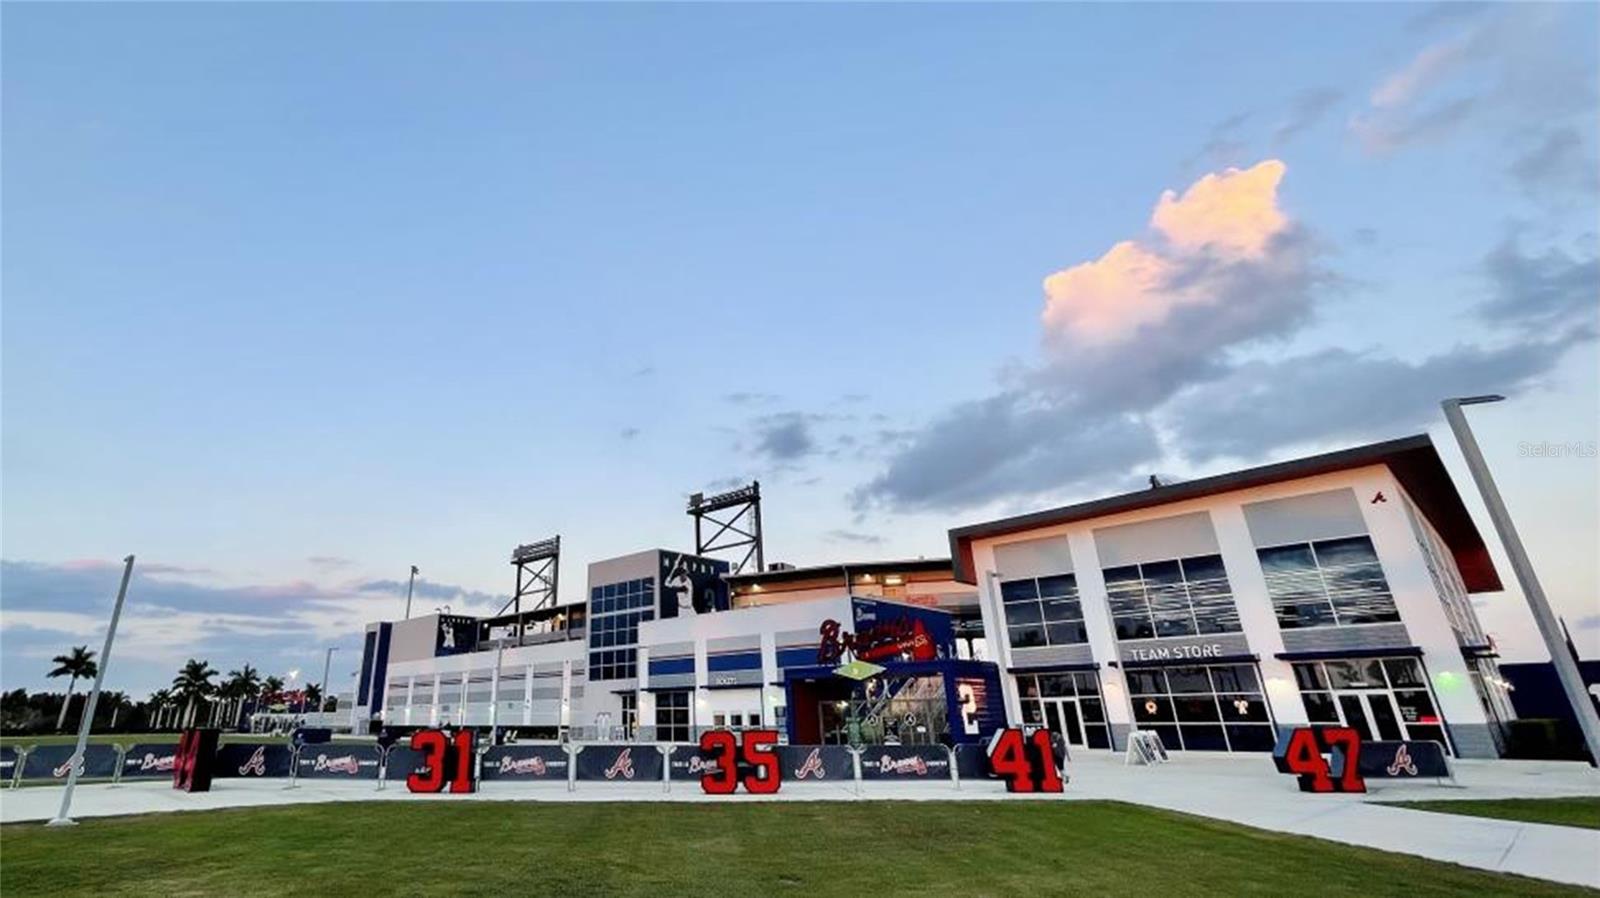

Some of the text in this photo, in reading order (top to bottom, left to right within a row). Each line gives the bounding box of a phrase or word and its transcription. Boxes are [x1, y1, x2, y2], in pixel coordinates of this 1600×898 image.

[1130, 644, 1222, 661] TEAM STORE
[957, 684, 979, 735] 2
[239, 746, 266, 776] A
[406, 729, 475, 793] 31
[605, 748, 635, 779] A
[701, 730, 781, 794] 35
[794, 748, 826, 779] A
[990, 728, 1064, 793] 41
[1286, 728, 1367, 793] 47
[1386, 744, 1418, 776] A
